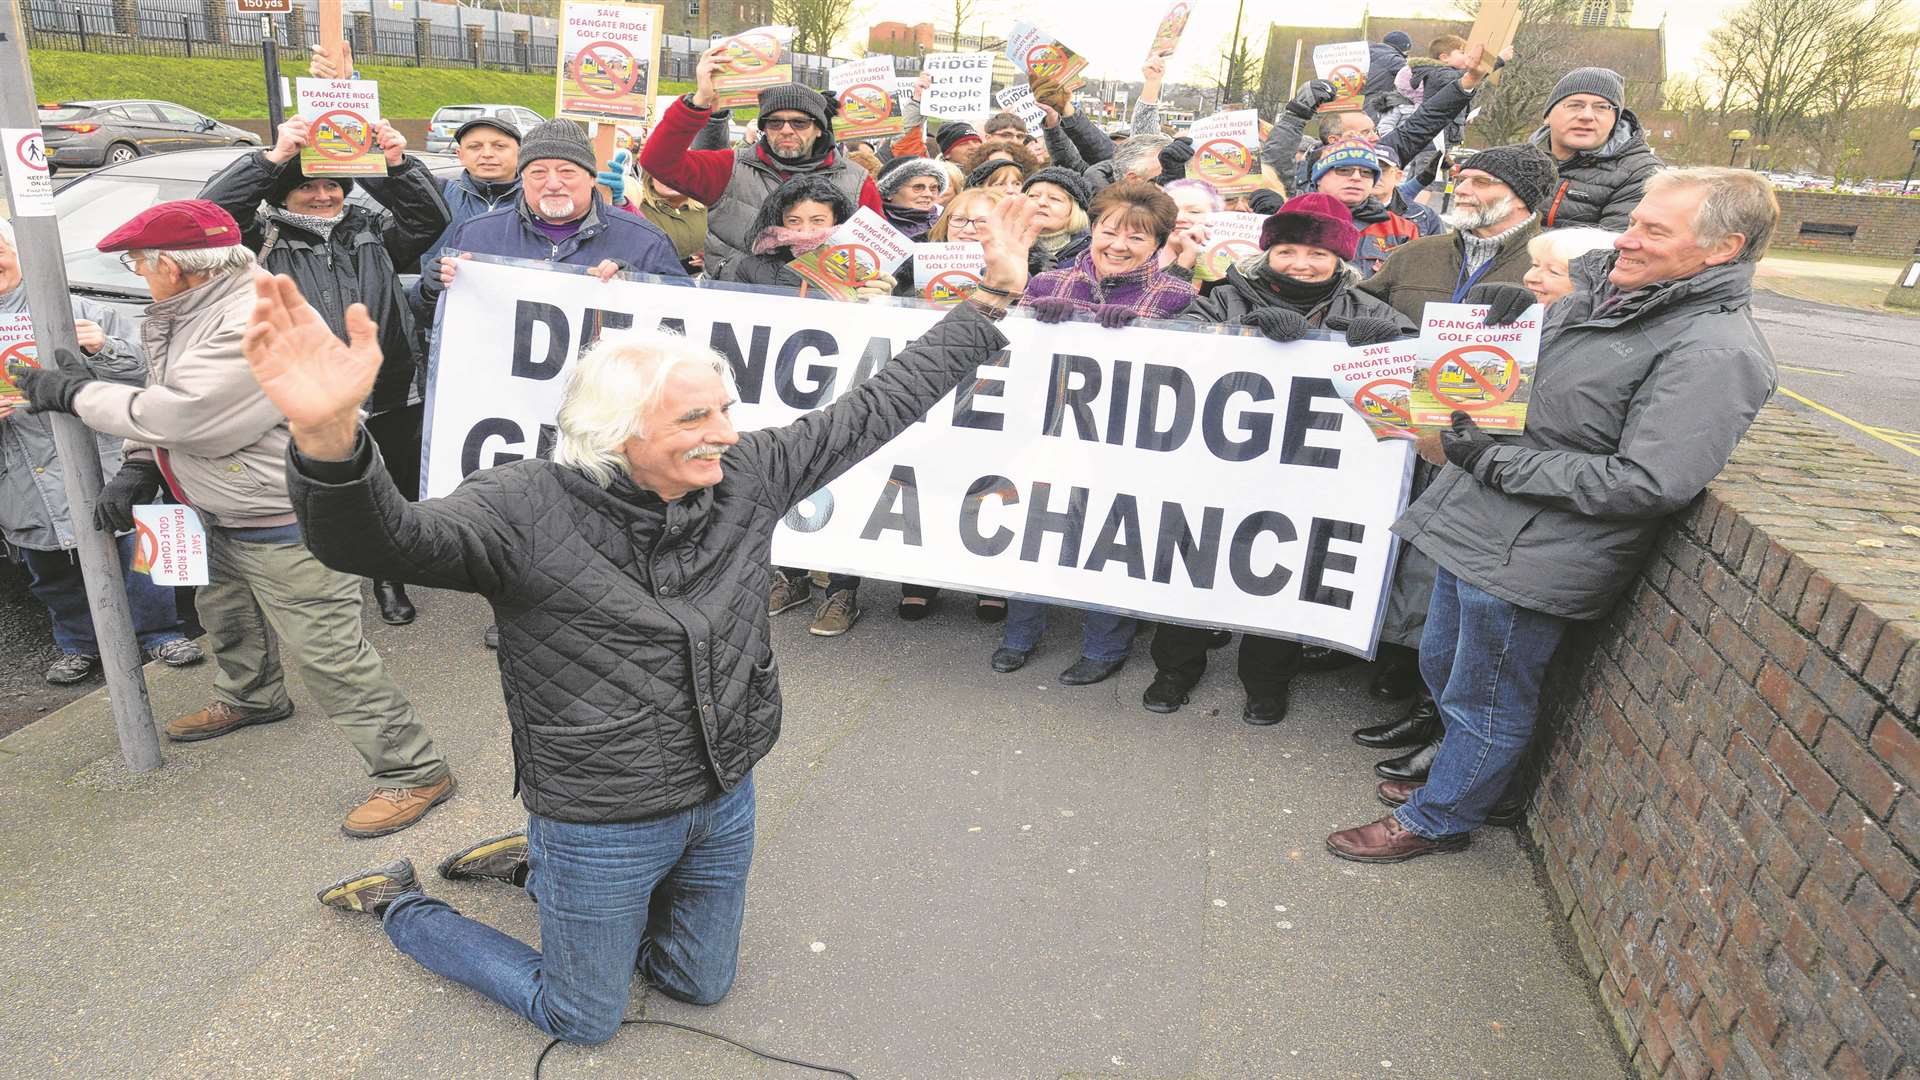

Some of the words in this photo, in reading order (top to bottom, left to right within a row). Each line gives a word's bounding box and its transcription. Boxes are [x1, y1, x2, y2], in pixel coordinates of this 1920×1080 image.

[244, 0, 263, 8] 150
[265, 0, 283, 9] yds
[597, 9, 620, 18] SAVE
[569, 18, 617, 29] DEANGATE
[619, 22, 648, 32] RIDGE
[577, 29, 601, 38] GOLF
[602, 32, 639, 42] COURSE
[928, 59, 989, 70] RIDGE
[330, 81, 352, 90] SAVE
[931, 75, 953, 84] Let
[959, 75, 983, 84] the
[301, 90, 352, 99] DEANGATE
[896, 89, 914, 99] RID
[930, 89, 982, 99] People
[311, 100, 335, 108] GOLF
[929, 103, 981, 114] Speak!
[1215, 130, 1247, 138] COURSE
[1316, 149, 1377, 171] MEDWA
[879, 223, 896, 238] SAVE
[853, 217, 888, 245] DEANGATE
[887, 240, 908, 259] RIDGE
[852, 229, 870, 246] GOLF
[869, 241, 896, 262] COURSE
[1438, 333, 1472, 342] GOLF
[1475, 333, 1522, 343] COURSE
[1363, 346, 1390, 357] SAVE
[1333, 357, 1391, 372] DEANGATE
[1392, 354, 1417, 362] RID
[1345, 370, 1374, 383] GOLF
[511, 299, 1011, 431] DNGAE
[1042, 353, 1345, 469] RIDGE
[159, 516, 170, 540] GOLF
[174, 508, 187, 554] DEANGATE
[859, 464, 922, 546] A
[959, 475, 1366, 610] CHANCE
[191, 534, 203, 555] SAVE
[161, 541, 173, 574] COURSE
[177, 555, 189, 582] RIDGE
